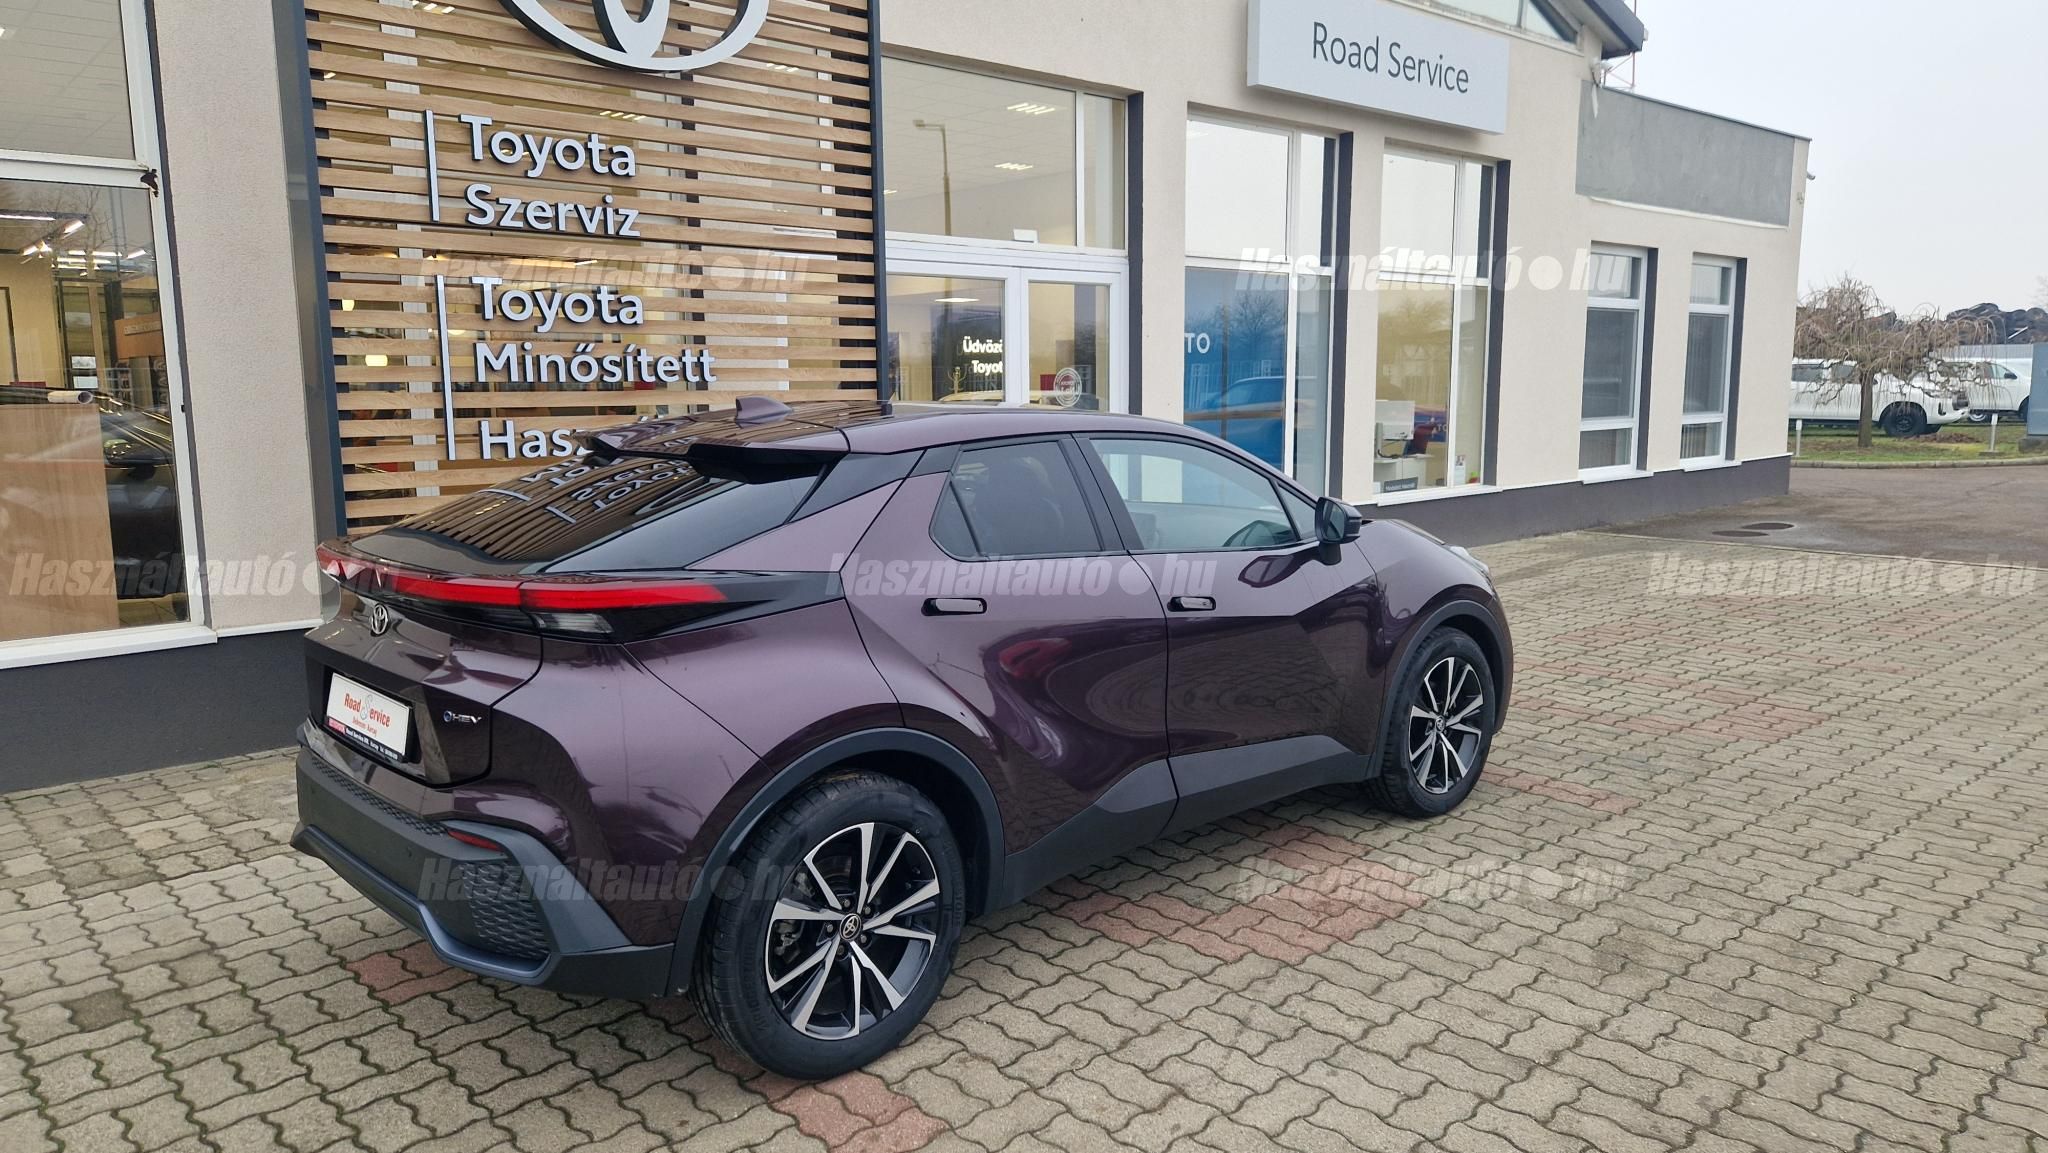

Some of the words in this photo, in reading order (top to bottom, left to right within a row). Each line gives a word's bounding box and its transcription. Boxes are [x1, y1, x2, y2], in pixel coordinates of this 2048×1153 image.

[1313, 22, 1379, 73] Road
[1388, 42, 1468, 93] Service
[459, 114, 636, 177] Toyota
[466, 184, 641, 237] Szerviz
[472, 277, 644, 333] Toyota
[475, 342, 718, 384] Minősített
[344, 693, 361, 712] Road
